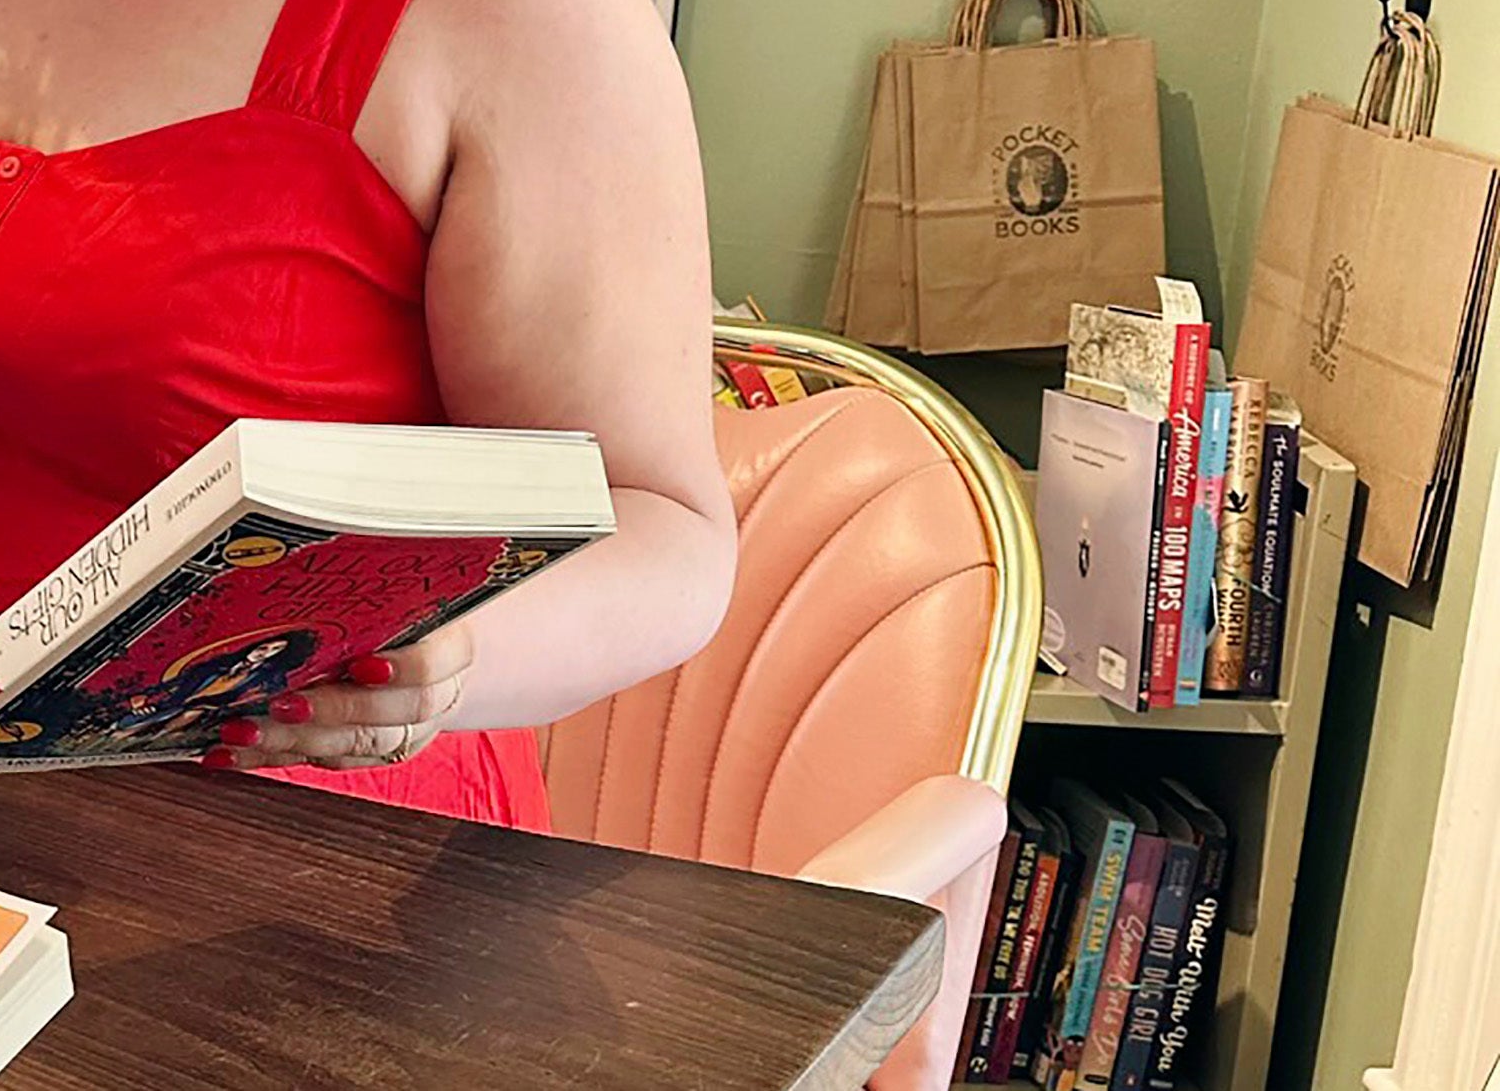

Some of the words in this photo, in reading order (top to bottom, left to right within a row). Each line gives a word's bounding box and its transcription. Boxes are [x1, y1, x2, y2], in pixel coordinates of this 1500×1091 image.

[991, 125, 1080, 163] POCKET
[995, 216, 1081, 239] BOOKS
[1172, 407, 1201, 498] America
[1244, 399, 1263, 479] REBECCA
[1267, 460, 1285, 526] SOULMATE
[68, 504, 151, 585] HIDDEN
[1163, 525, 1188, 557] 100
[1260, 529, 1278, 596] EQUATION
[84, 556, 122, 606] ALL
[1158, 559, 1185, 611] MAPS
[8, 575, 64, 640] GIFTS
[39, 592, 85, 646] OUR
[1226, 577, 1248, 647] FOURTH
[1101, 850, 1122, 902] SWIM
[1087, 906, 1110, 955] TEAM
[1146, 923, 1180, 960] HOT
[1138, 965, 1170, 1001] DOG
[1127, 1006, 1160, 1043] GIRL
